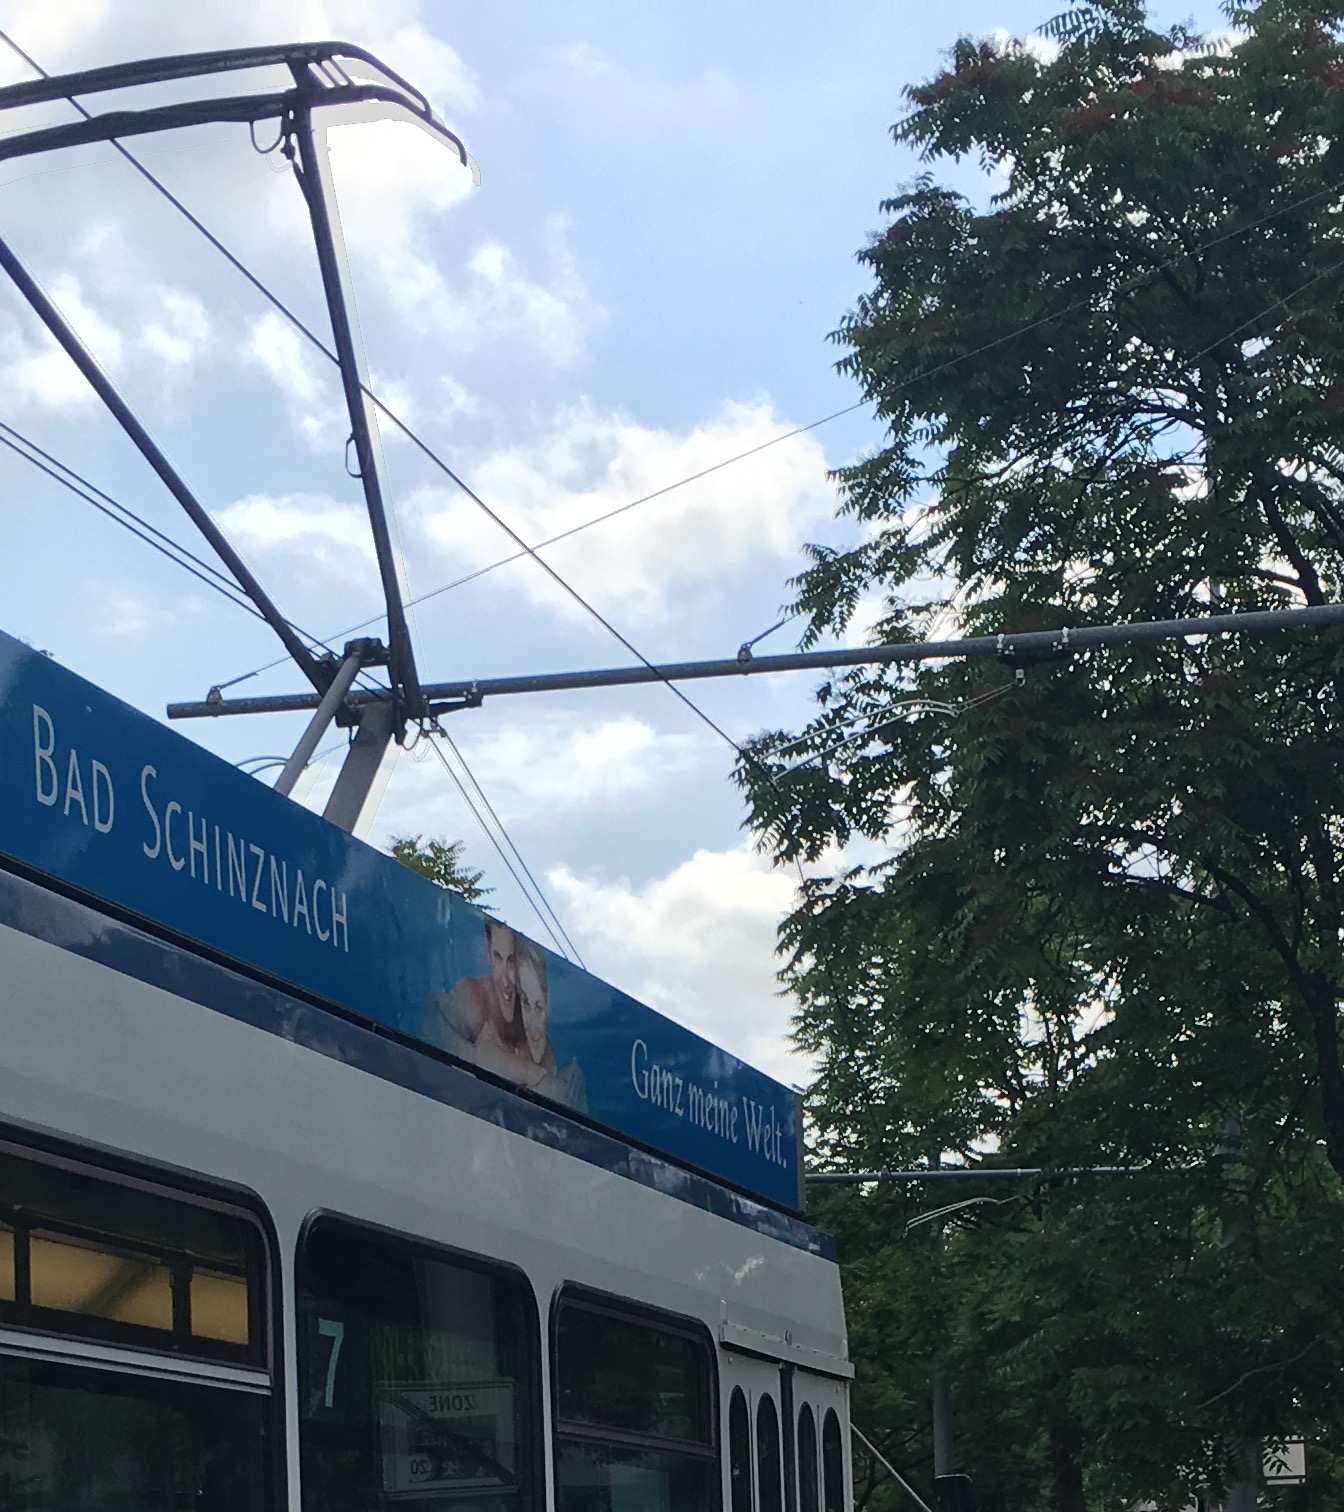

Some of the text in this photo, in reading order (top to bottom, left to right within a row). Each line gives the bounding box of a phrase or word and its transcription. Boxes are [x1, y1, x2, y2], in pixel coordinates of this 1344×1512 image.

[32, 703, 349, 953] BAD SCHINZNACH
[631, 1039, 787, 1169] Ganz meine Welt.
[318, 1318, 345, 1408] 7
